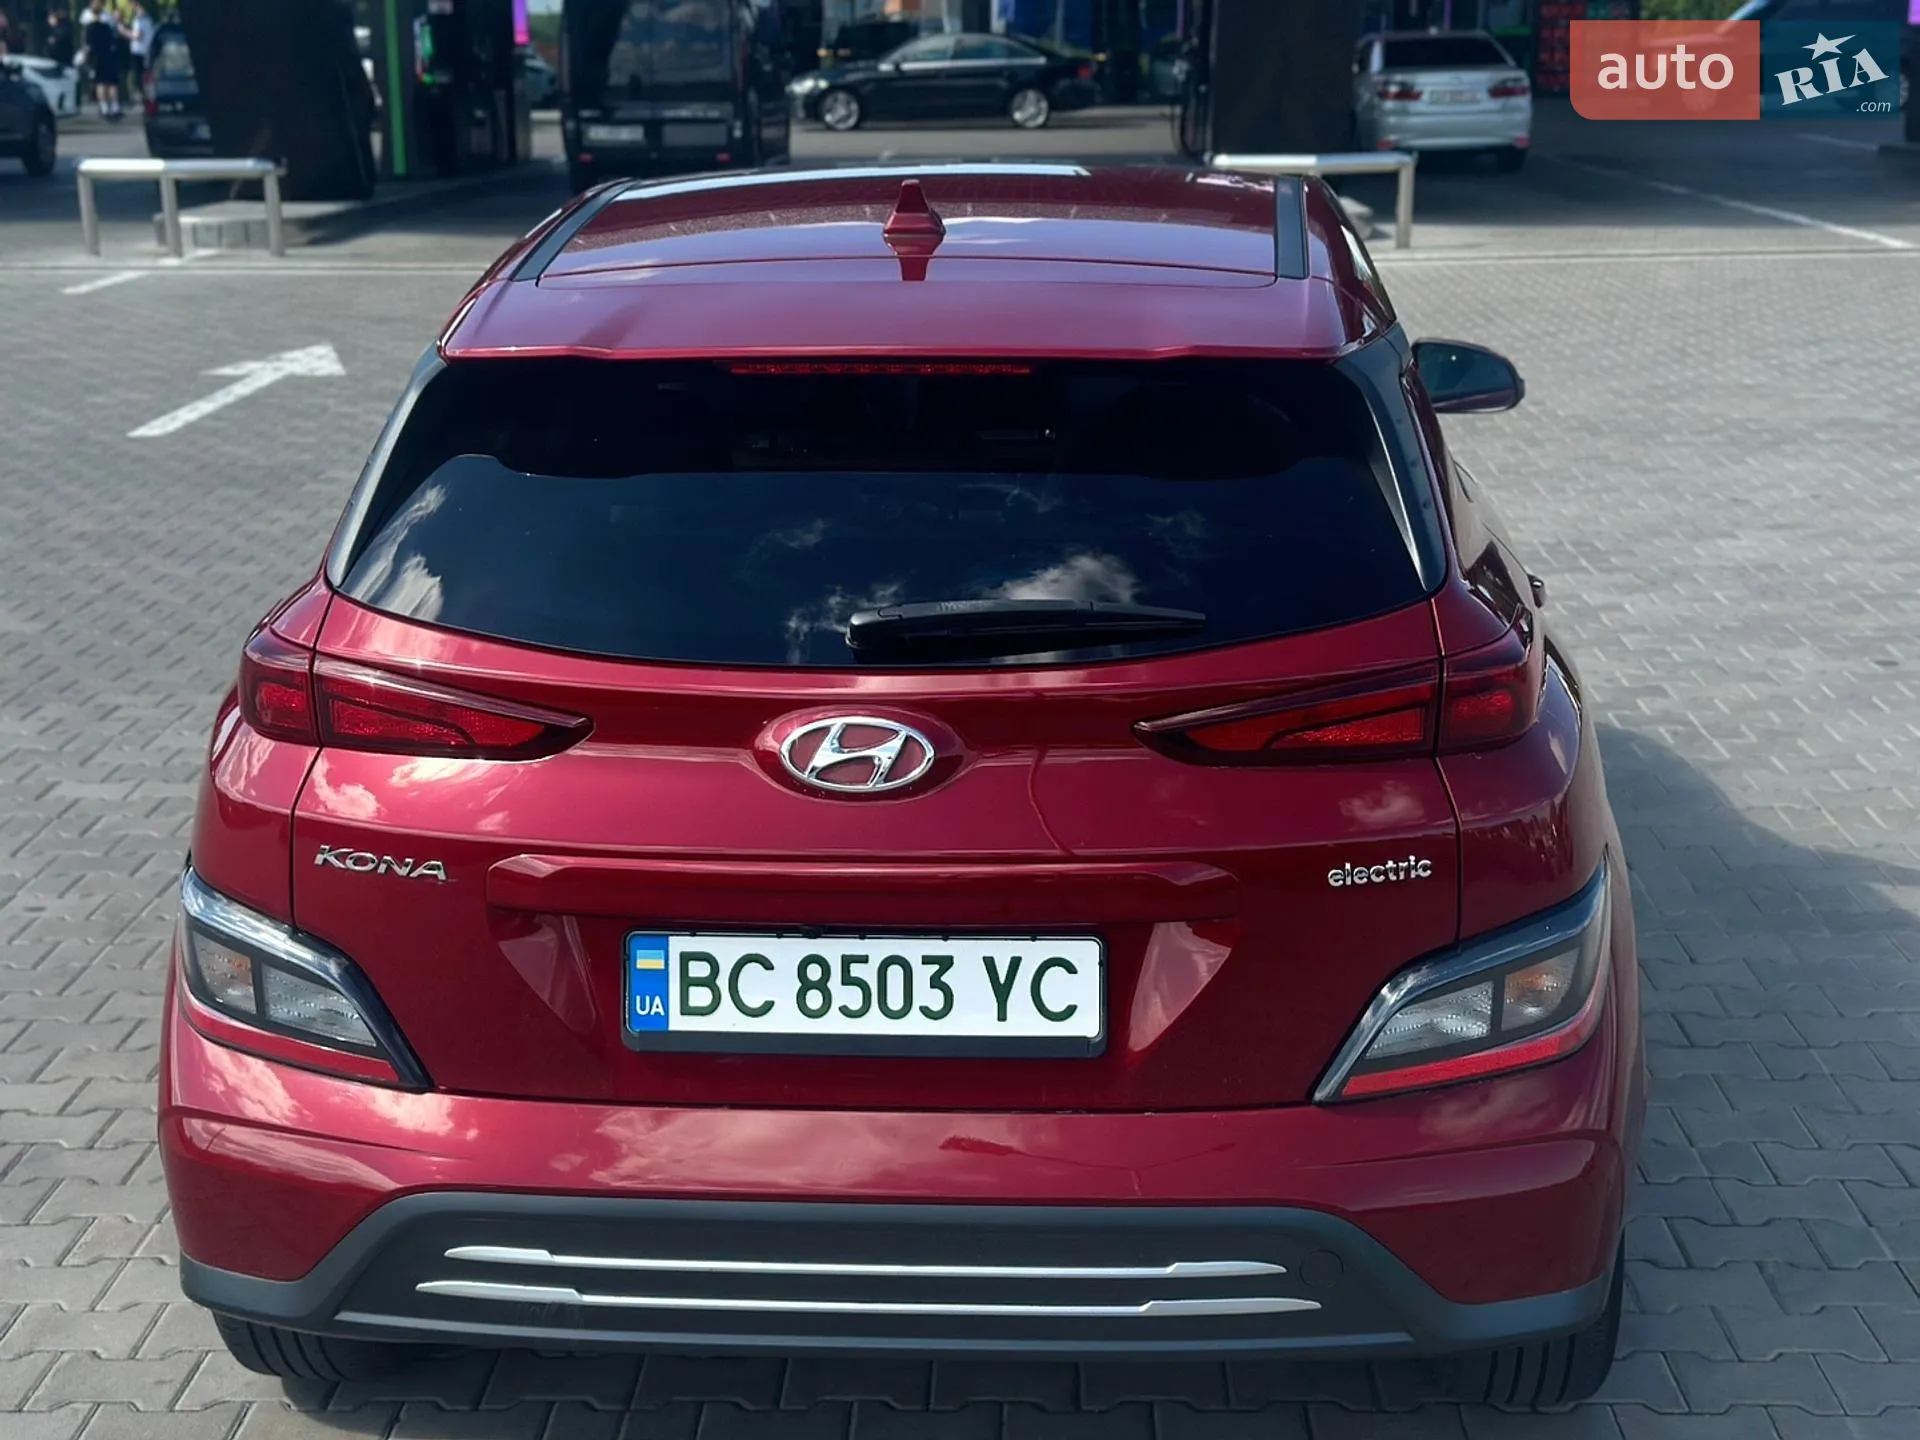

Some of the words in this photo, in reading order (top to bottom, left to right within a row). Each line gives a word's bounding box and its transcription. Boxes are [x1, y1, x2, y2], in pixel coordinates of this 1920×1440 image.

[314, 844, 447, 881] KONA
[1327, 855, 1432, 887] electric
[678, 951, 775, 1018] BC
[796, 953, 954, 1021] 8503
[982, 955, 1078, 1022] YC
[635, 995, 665, 1017] UA
